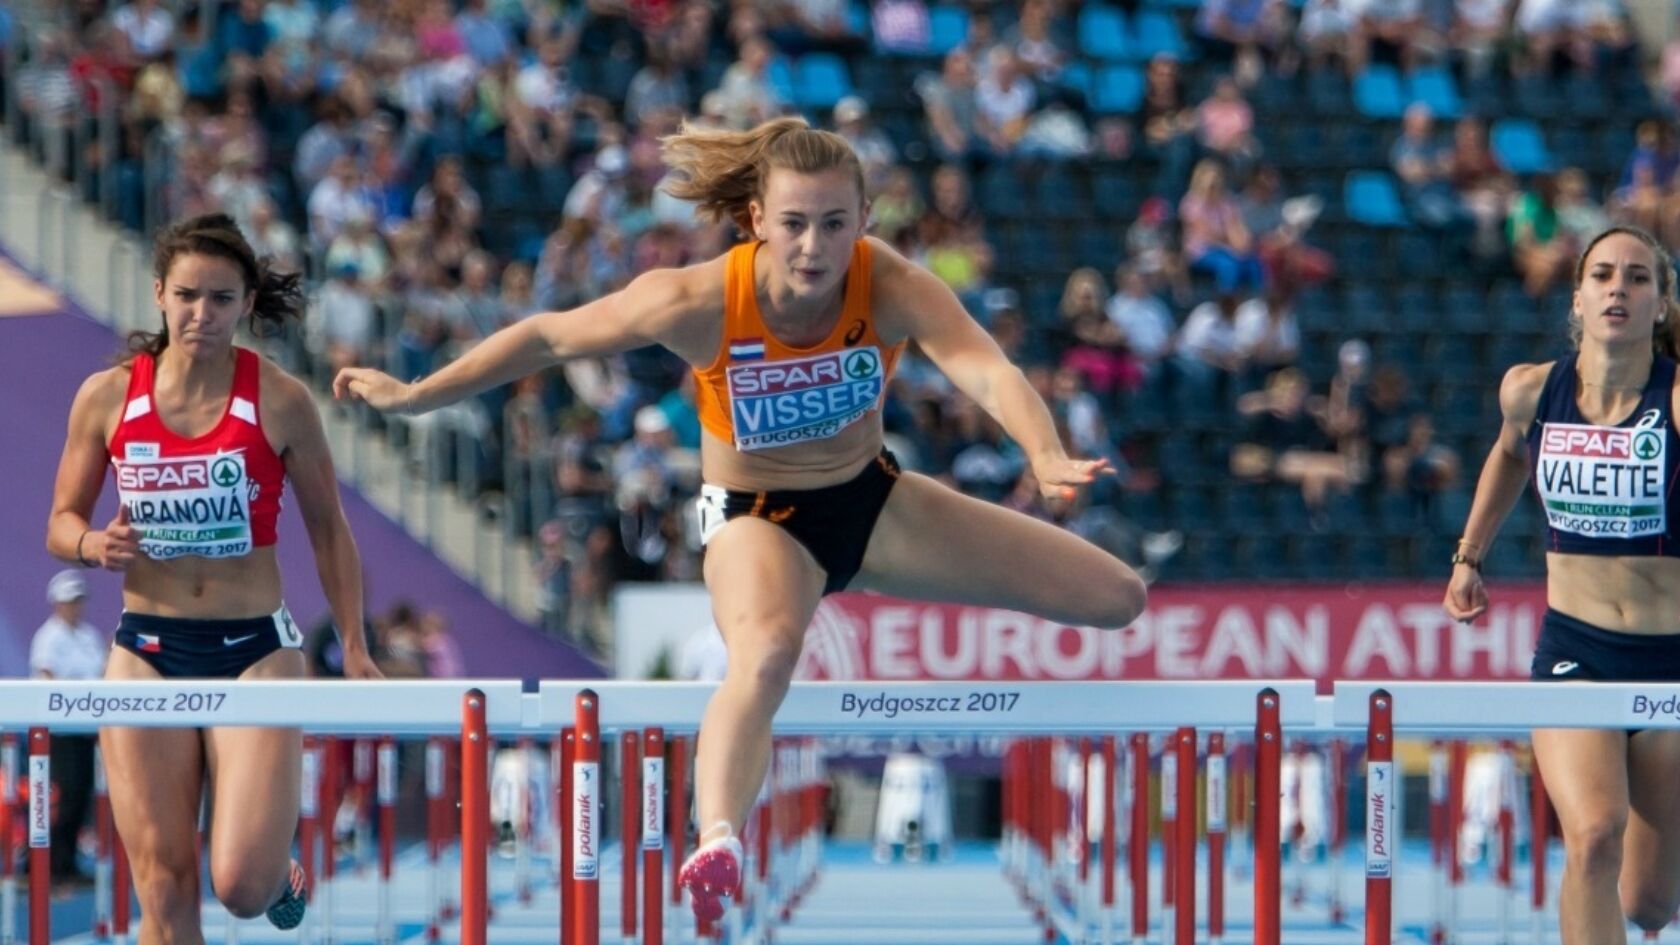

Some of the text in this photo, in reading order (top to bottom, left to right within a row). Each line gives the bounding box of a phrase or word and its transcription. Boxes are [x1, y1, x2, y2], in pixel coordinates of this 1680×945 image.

[733, 362, 840, 393] SPAR
[737, 381, 876, 432] VISSER
[1545, 430, 1629, 456] SPAR
[119, 464, 207, 489] SPAR
[1543, 459, 1659, 498] VALETTE
[1549, 512, 1661, 533] BYDGOSZCZ 2017
[1570, 504, 1594, 514] RUN
[1595, 505, 1630, 515] CLEAN
[217, 542, 248, 555] 2017
[870, 603, 1331, 680] EUROPEAN
[48, 692, 226, 718] Bydgoszcz 2017
[841, 692, 1020, 718] Bydgoszcz 2017
[1633, 694, 1680, 720] Byd
[577, 793, 594, 858] polanik
[1371, 793, 1387, 857] polanik
